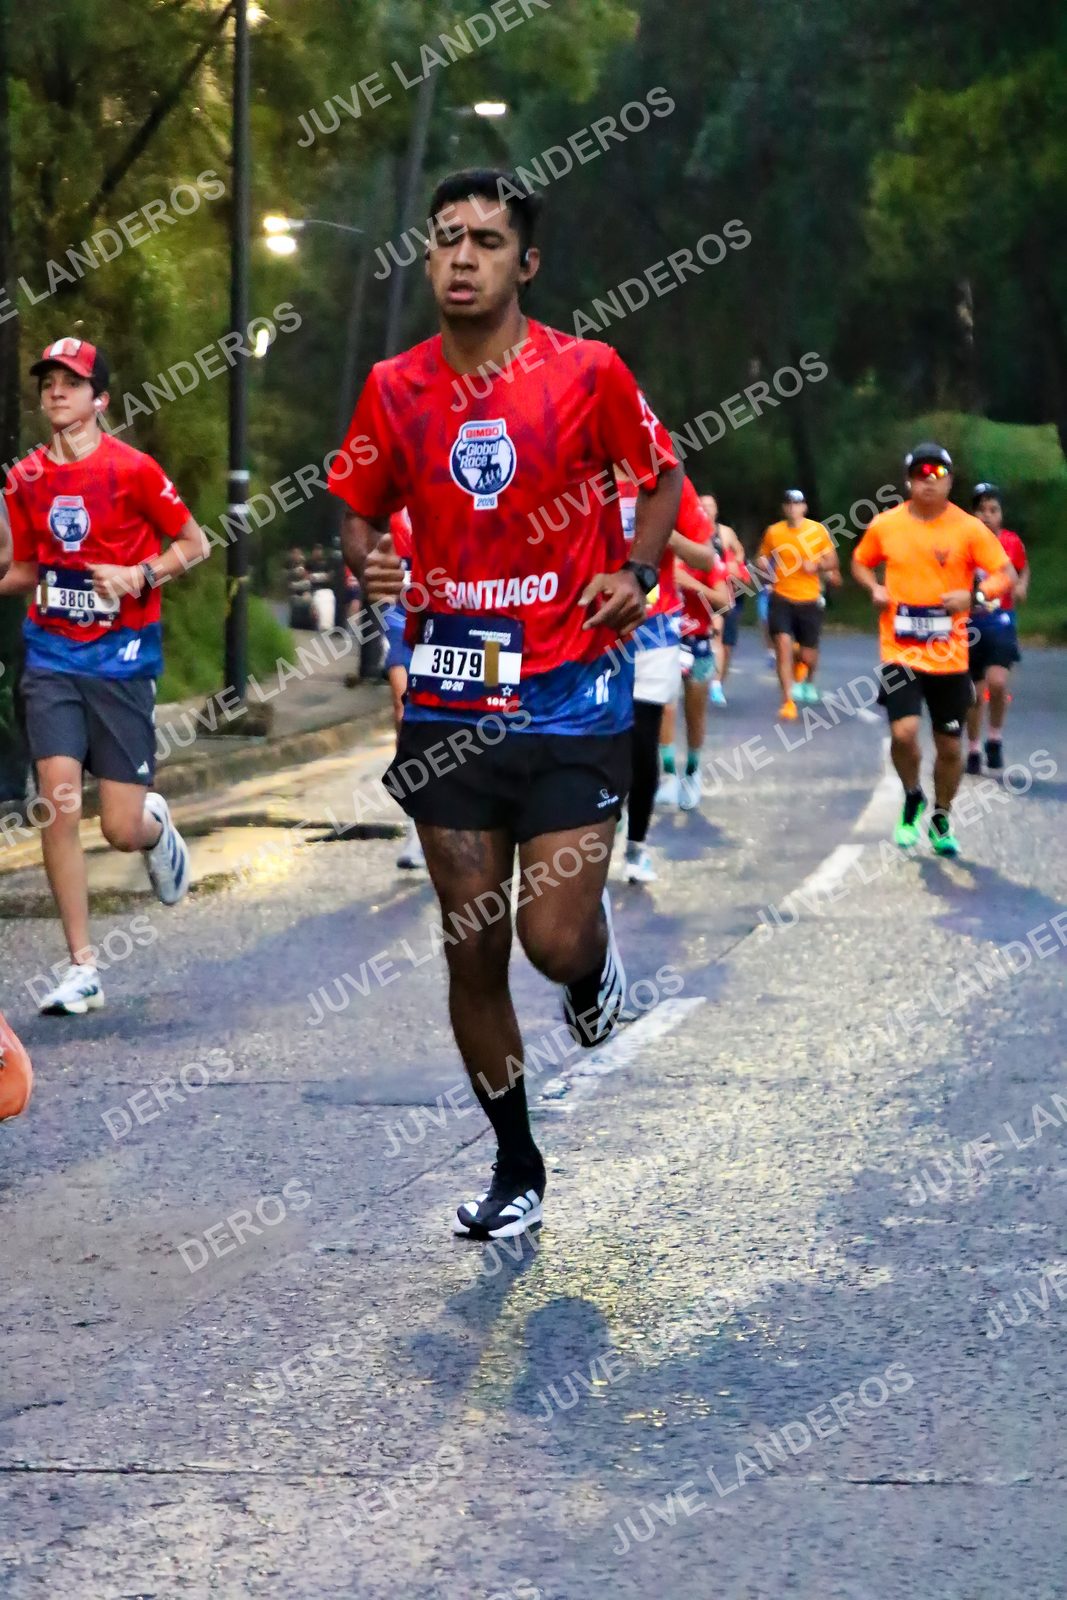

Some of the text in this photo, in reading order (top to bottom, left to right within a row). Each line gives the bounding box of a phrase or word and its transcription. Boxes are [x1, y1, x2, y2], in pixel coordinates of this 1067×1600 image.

[467, 441, 499, 456] Global
[461, 455, 488, 468] Race
[59, 589, 96, 608] 3806
[444, 571, 559, 610] SANTIAGO
[431, 648, 482, 678] 3979
